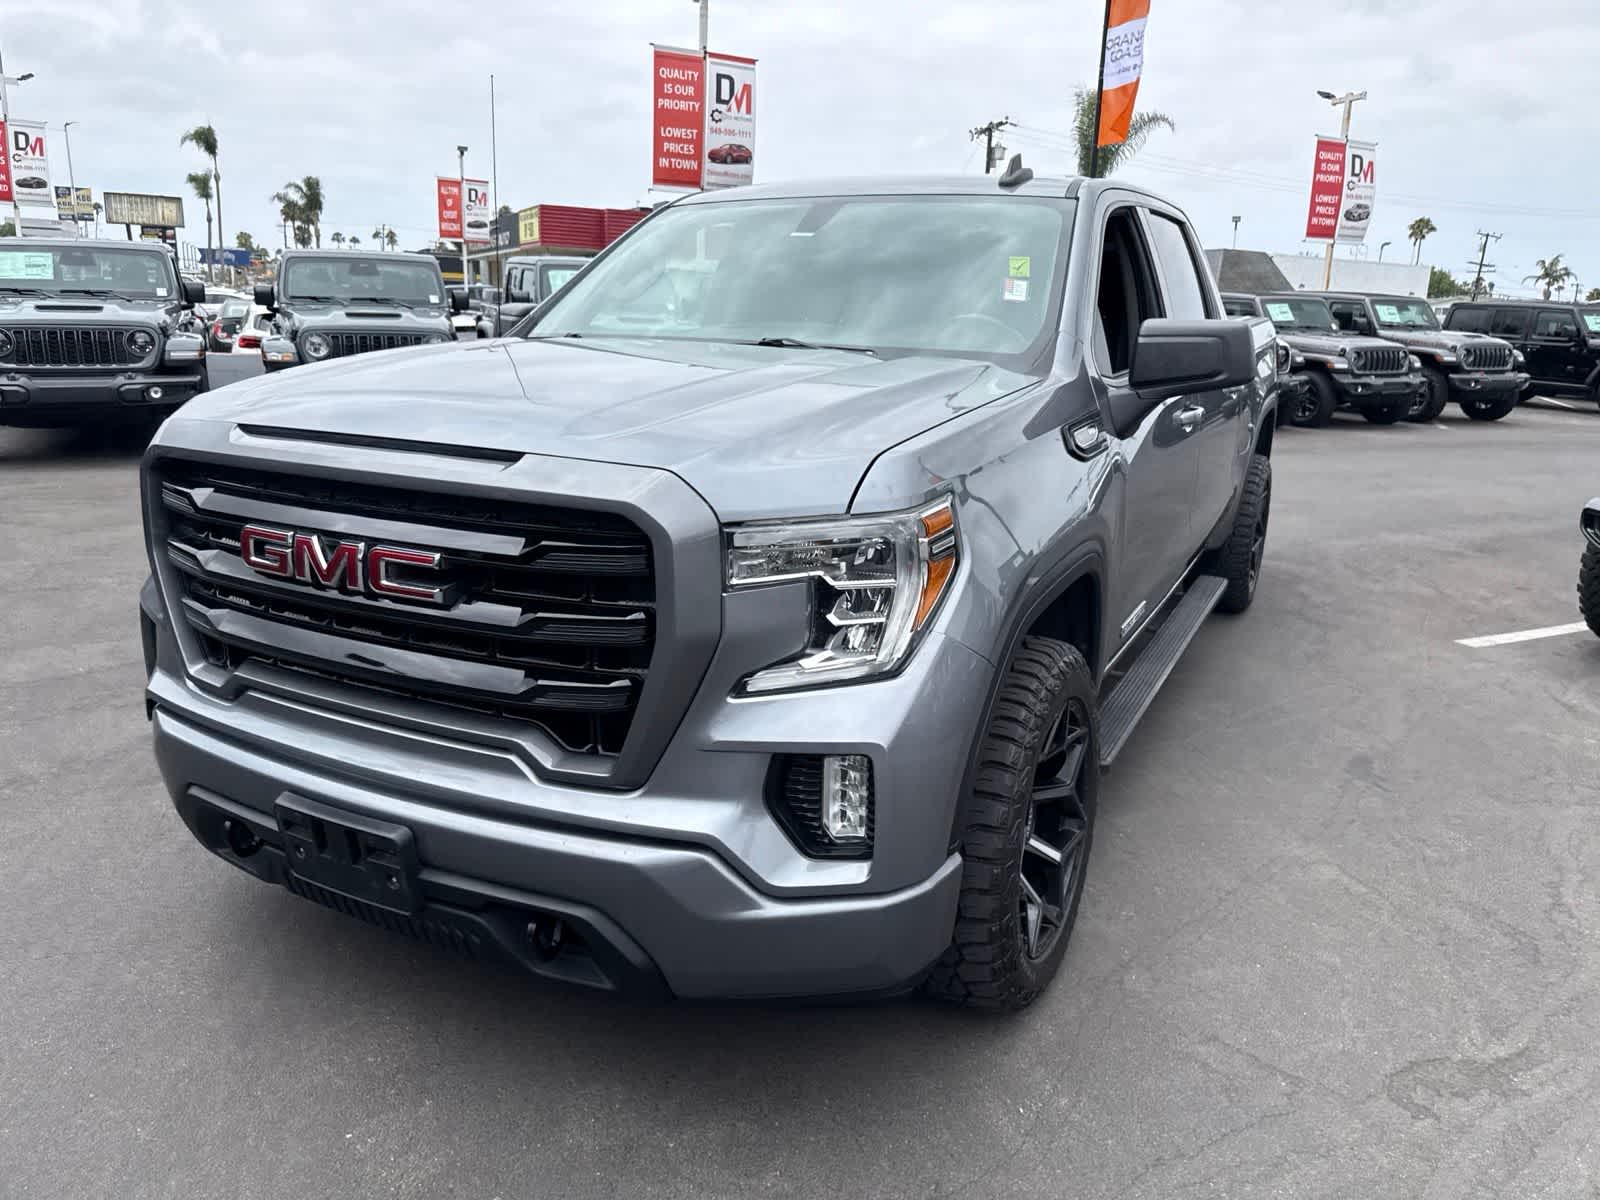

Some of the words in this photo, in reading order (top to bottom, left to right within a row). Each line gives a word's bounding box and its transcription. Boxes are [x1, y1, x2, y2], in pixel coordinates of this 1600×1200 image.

[1110, 45, 1142, 62] COAS
[659, 67, 699, 81] QUALITY
[664, 83, 673, 94] IS
[674, 84, 695, 97] OUR
[657, 98, 701, 112] PRIORITY
[660, 127, 698, 139] LOWEST
[663, 142, 695, 155] PRICES
[1319, 151, 1344, 161] QUALITY
[659, 157, 669, 168] IN
[670, 158, 698, 171] TOWN
[1327, 163, 1340, 172] OUR
[1316, 174, 1342, 183] PRIORITY
[1315, 194, 1339, 203] LOWEST
[1315, 205, 1336, 215] PRICES
[1311, 217, 1318, 225] IN
[1318, 217, 1336, 226] TOWN
[239, 523, 445, 604] GMC
